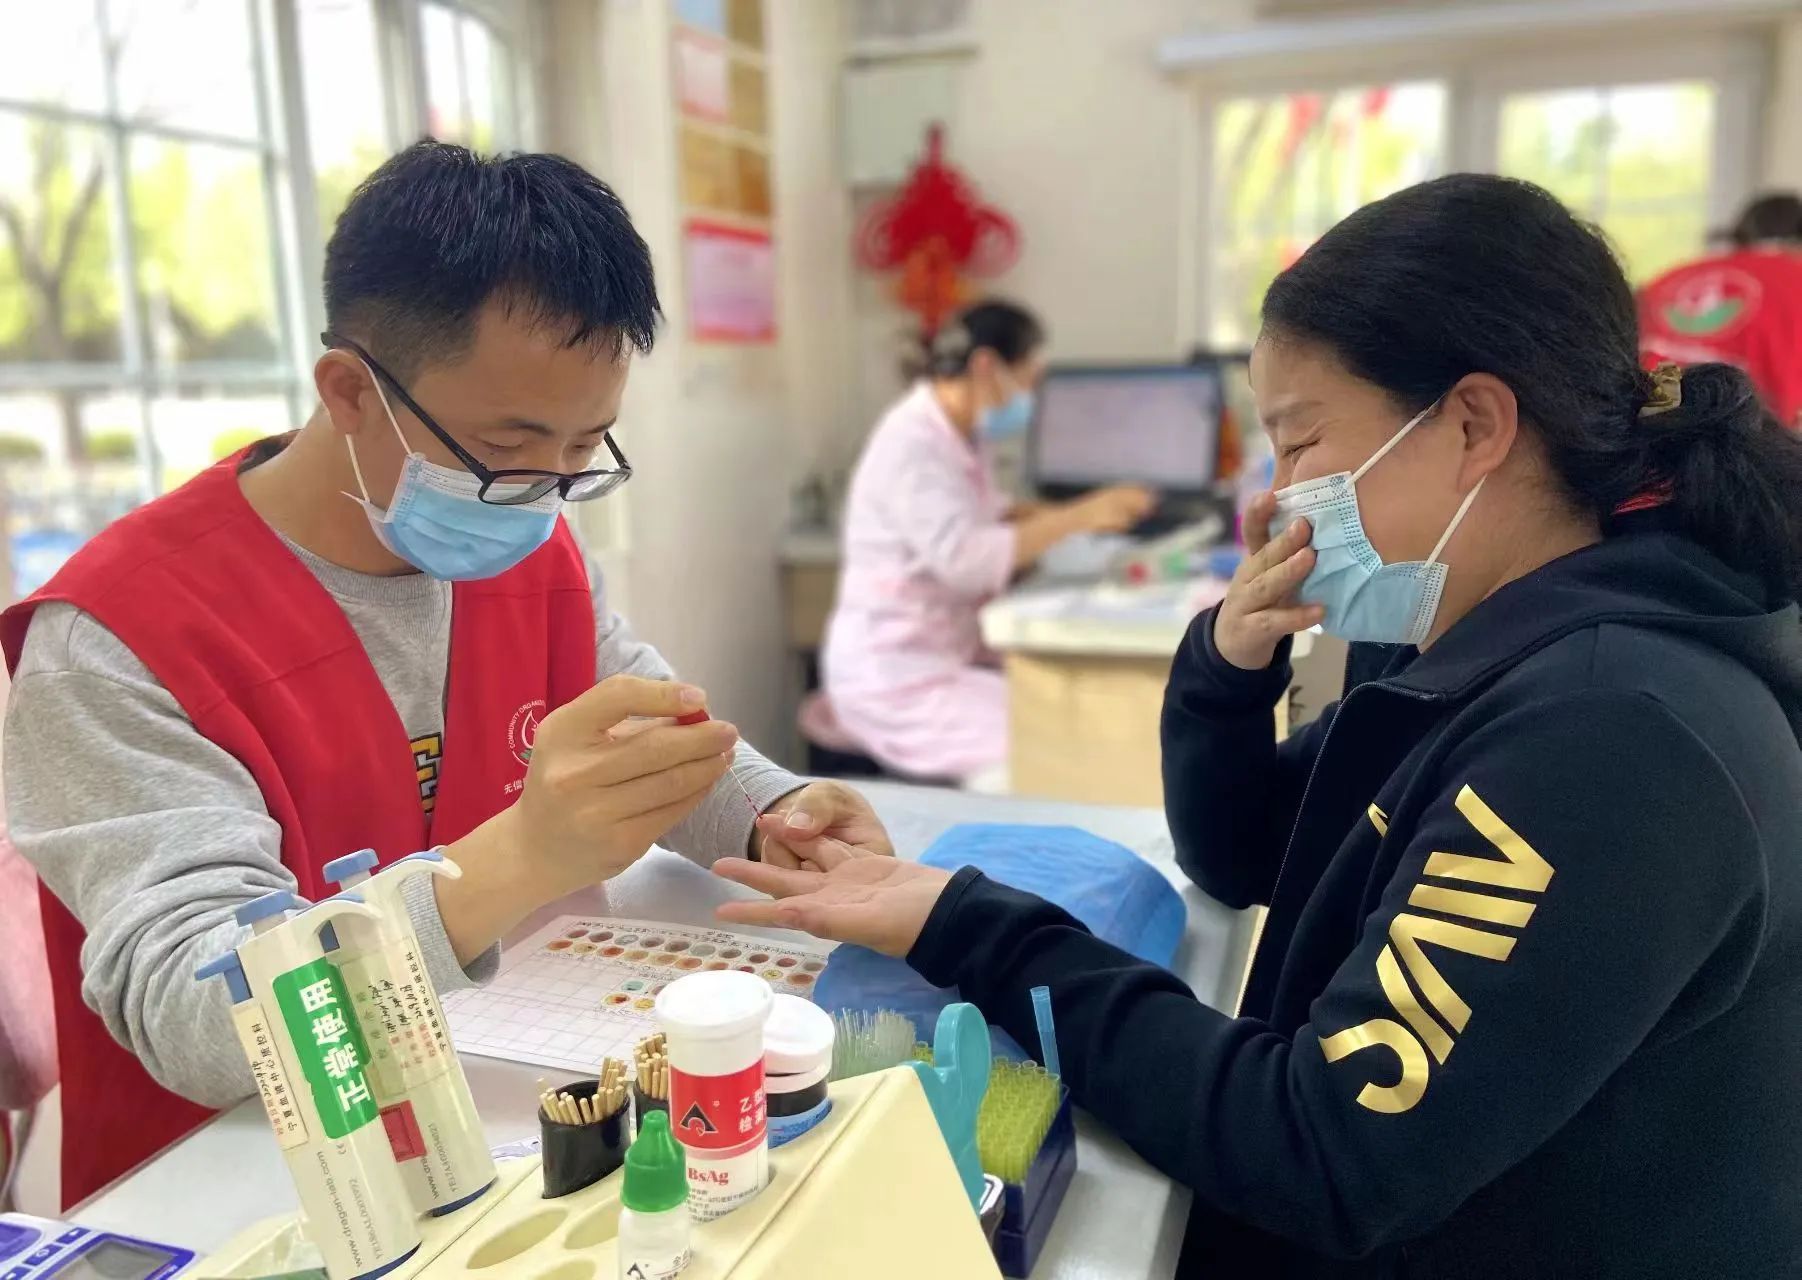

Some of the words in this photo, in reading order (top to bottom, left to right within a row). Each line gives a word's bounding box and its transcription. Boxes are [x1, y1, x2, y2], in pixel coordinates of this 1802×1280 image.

[507, 712, 520, 749] COMMUNITY
[251, 1023, 298, 1131] 宁夏血液中心质控科
[298, 977, 371, 1112] 正常使用
[316, 1150, 363, 1268] www.dragon-lab.com
[688, 1167, 729, 1186] BsAg
